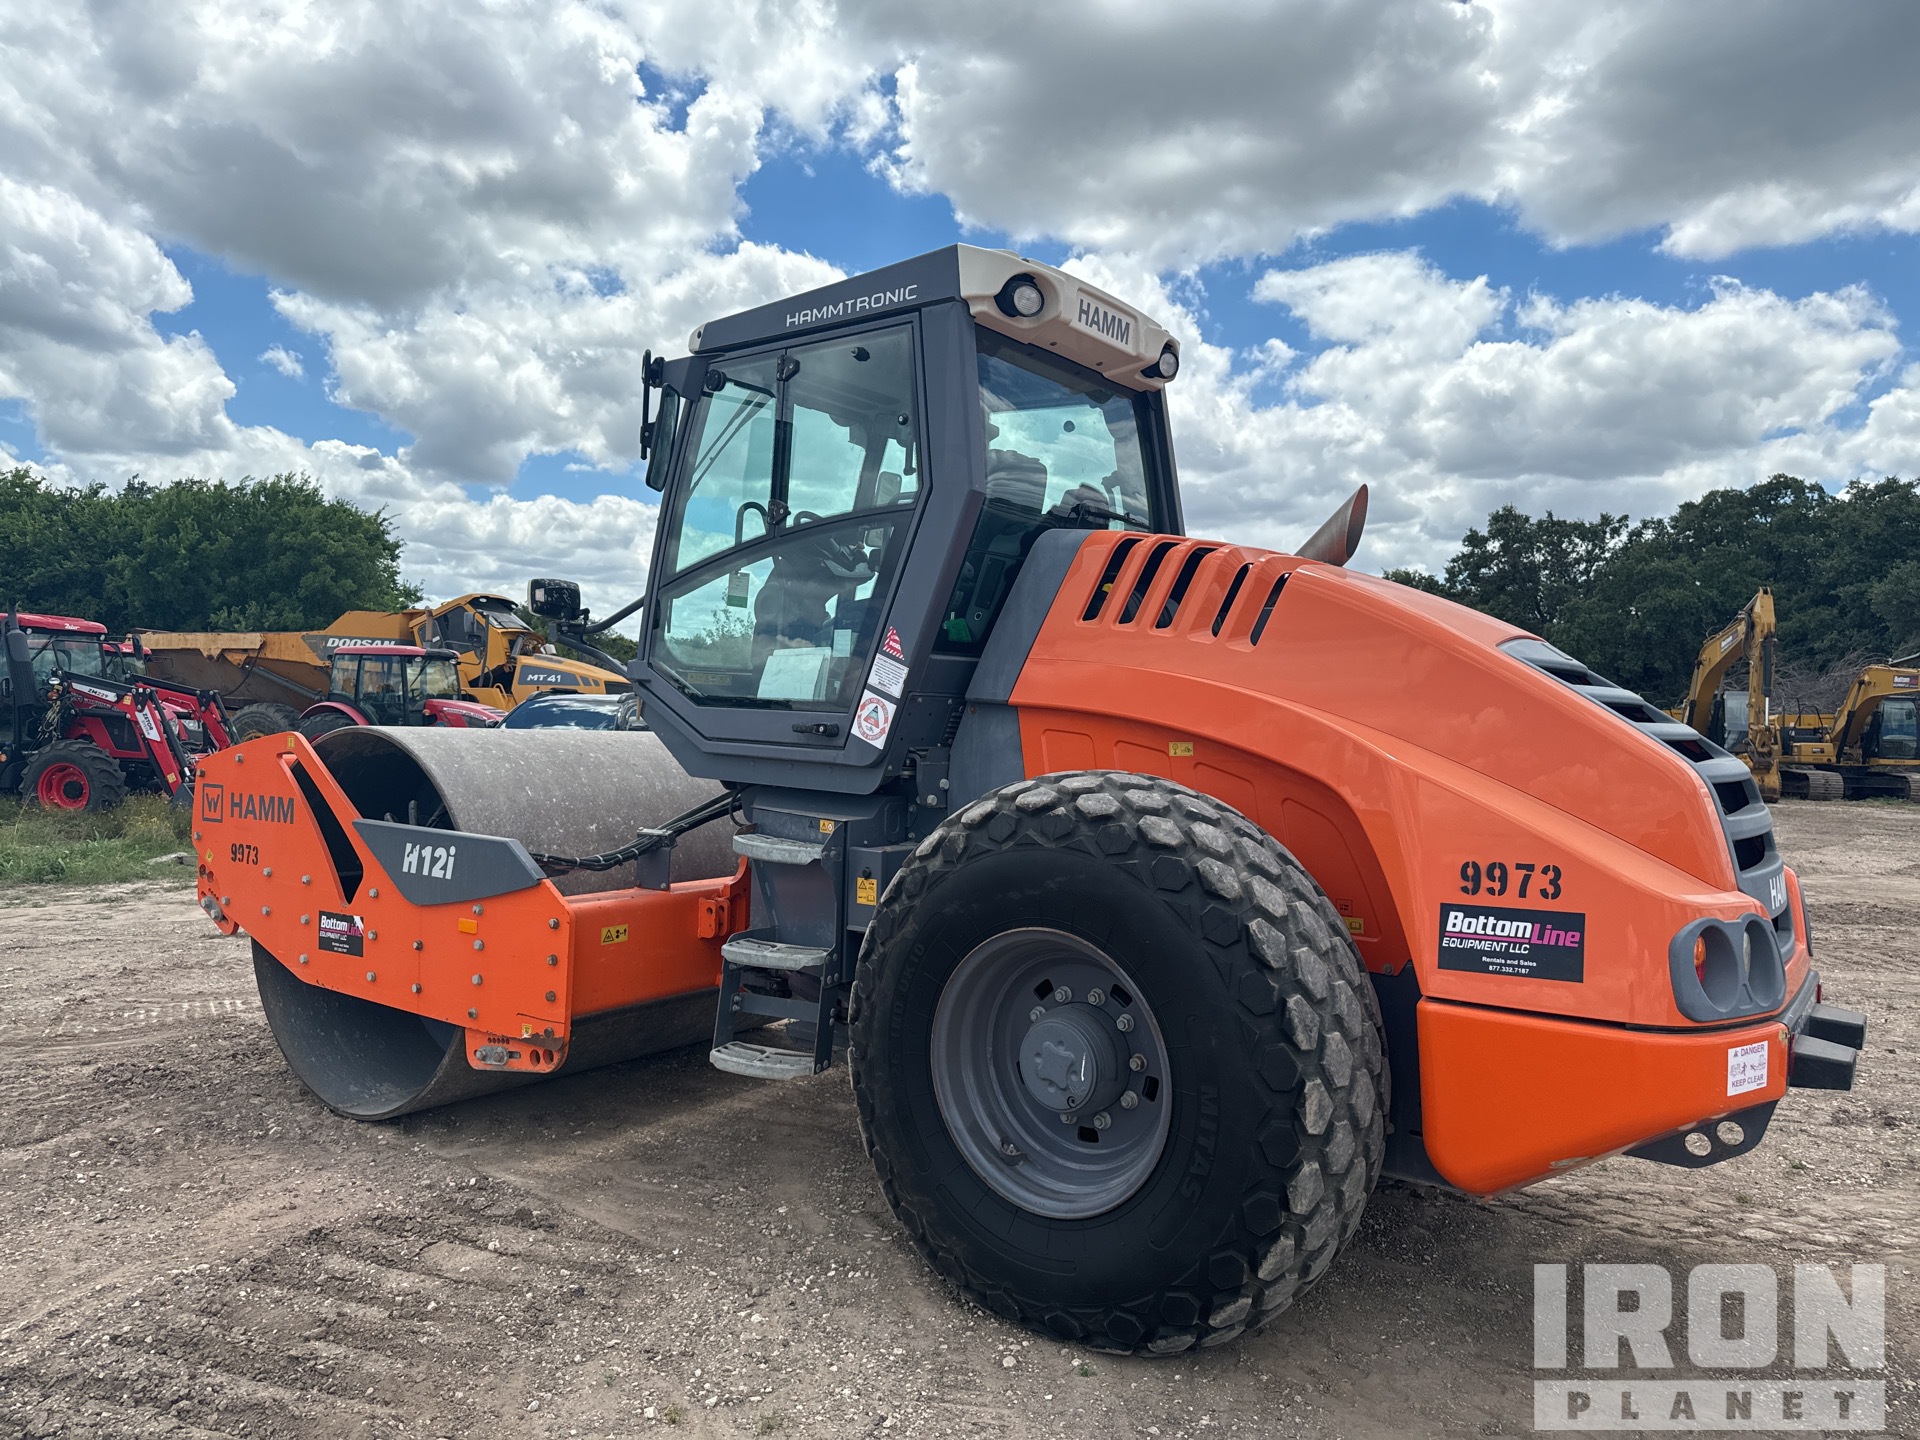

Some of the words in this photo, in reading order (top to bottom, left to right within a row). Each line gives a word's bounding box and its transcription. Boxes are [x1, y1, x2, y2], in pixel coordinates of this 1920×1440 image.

[786, 284, 918, 327] HAMMTRONIC
[1078, 298, 1130, 345] HAMM
[326, 637, 396, 648] DOOSAN
[526, 673, 546, 682] MT
[546, 674, 562, 683] 41
[205, 792, 221, 814] W
[230, 792, 295, 825] HAMM
[231, 843, 259, 866] 9973
[402, 842, 456, 880] H12i
[1460, 861, 1562, 900] 9973
[1442, 937, 1508, 952] EQUIPMENT
[1509, 943, 1530, 955] LLC
[1481, 956, 1505, 964] Rentals
[1506, 958, 1518, 966] and
[1519, 959, 1537, 967] Sales
[1488, 965, 1530, 974] 877.332.7187
[1740, 1043, 1765, 1057] DANGER
[1731, 1078, 1746, 1088] KEEP
[1746, 1073, 1764, 1085] CLEAR
[1180, 1085, 1219, 1204] MITAS
